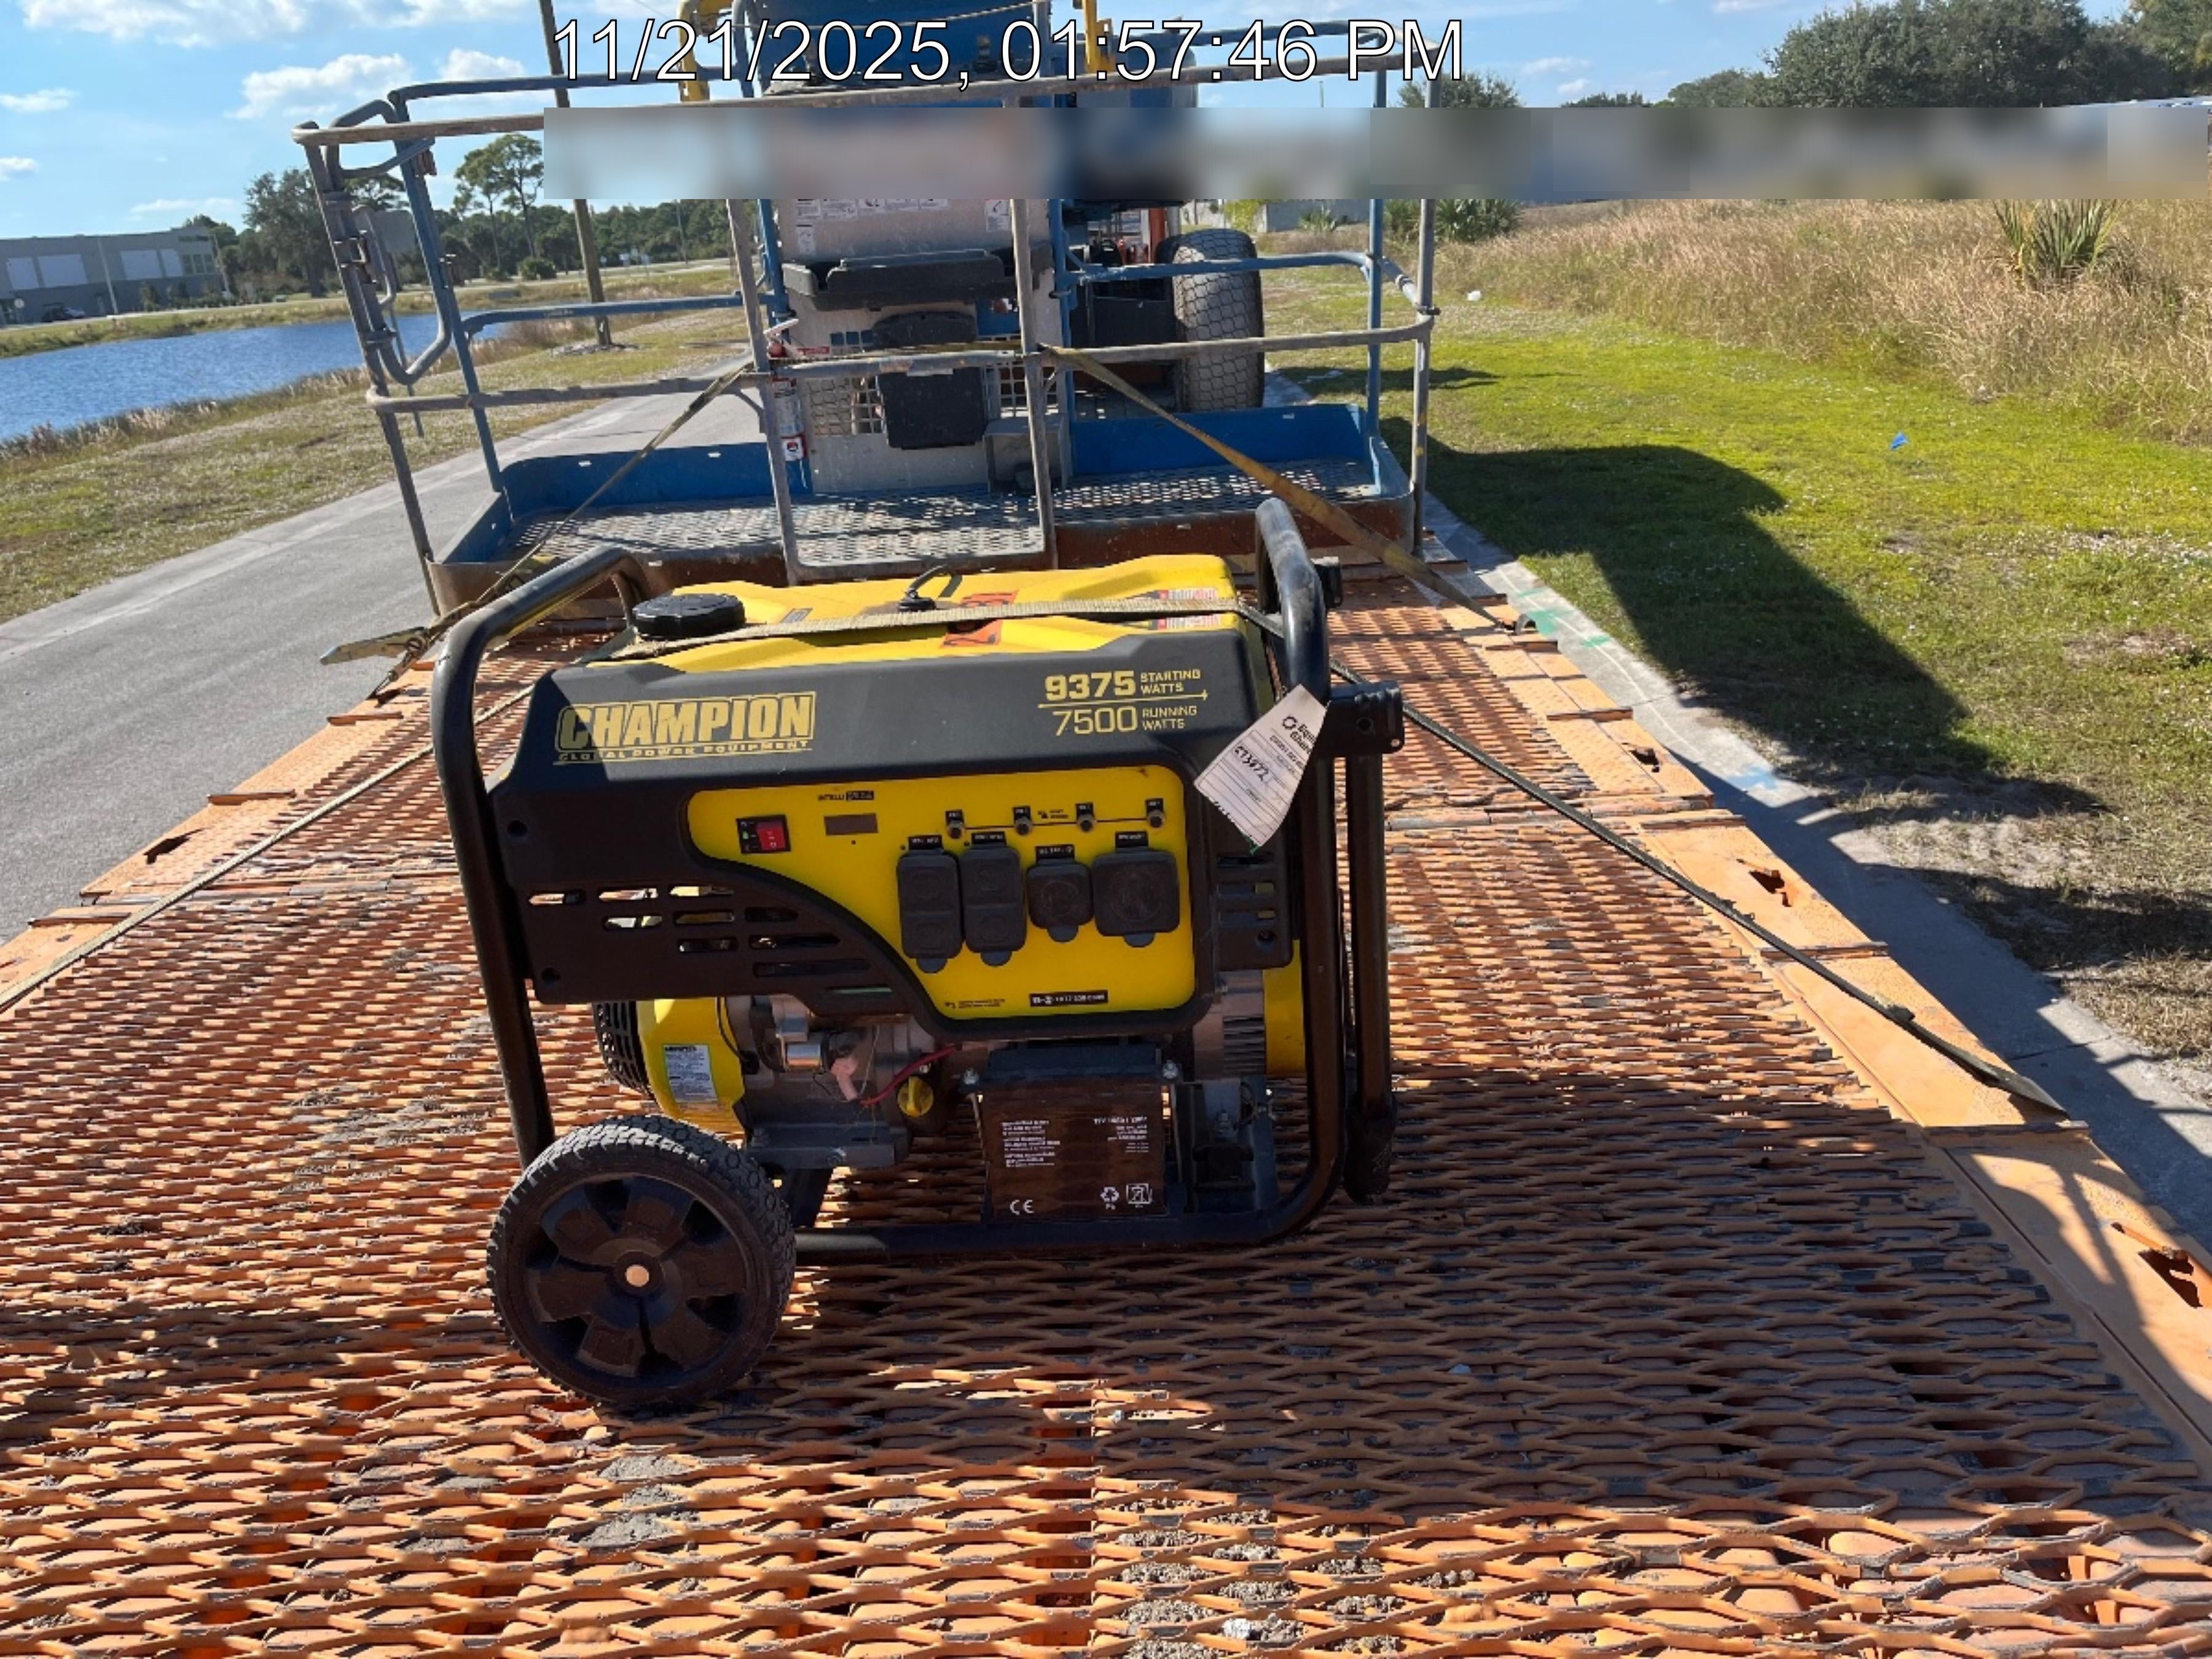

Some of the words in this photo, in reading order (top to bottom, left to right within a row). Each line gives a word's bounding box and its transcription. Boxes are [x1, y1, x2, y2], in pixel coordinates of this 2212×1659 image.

[1045, 670, 1136, 700] 9375
[1140, 669, 1201, 683] STARTING
[1140, 682, 1183, 695] WATTS
[1052, 705, 1138, 736] 7500
[1142, 705, 1197, 718] RUNNING
[558, 693, 814, 749] CHAMPION
[1143, 718, 1185, 731] WATTS
[558, 750, 626, 762] GLOBAL
[632, 746, 695, 758] POWER
[703, 740, 809, 753] EQUIPMENT
